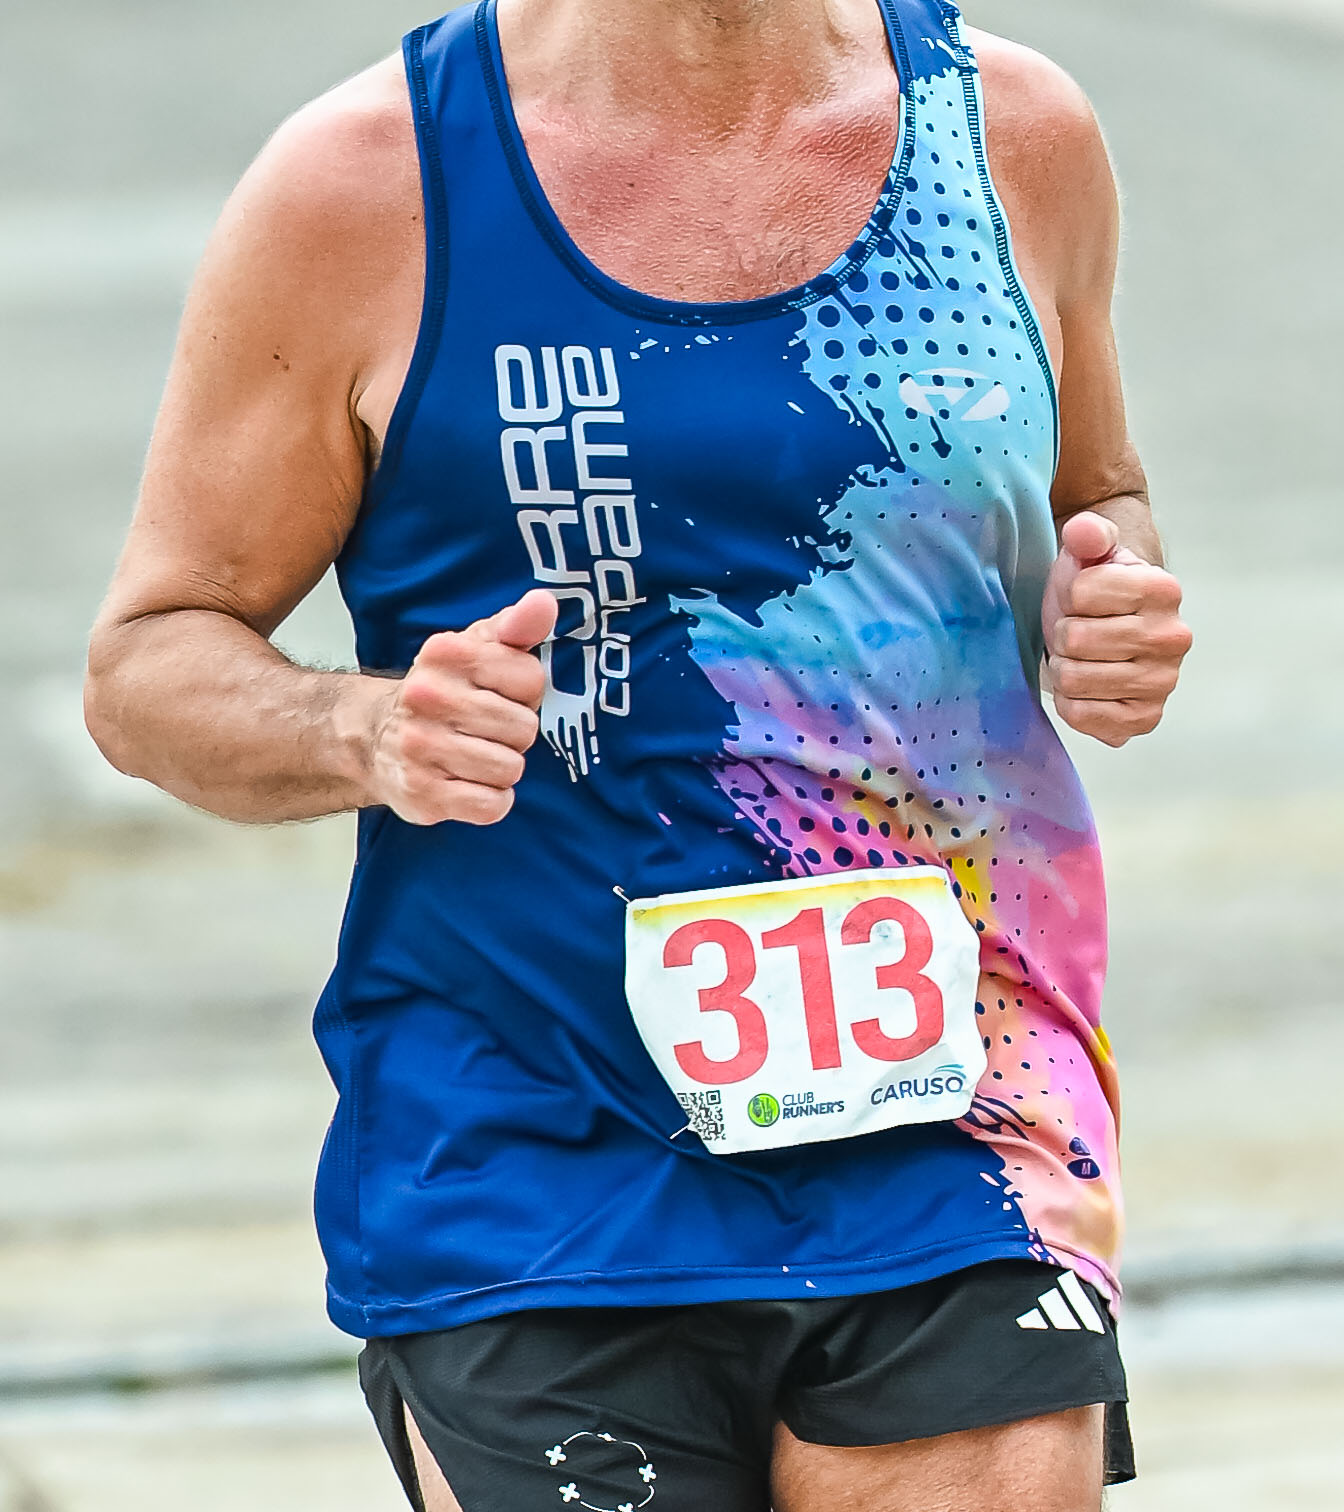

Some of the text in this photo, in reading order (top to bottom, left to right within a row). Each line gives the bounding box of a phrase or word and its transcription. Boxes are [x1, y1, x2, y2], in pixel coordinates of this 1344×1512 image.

[663, 897, 945, 1085] 313
[782, 1092, 814, 1106] CLUB
[871, 1076, 964, 1105] CARUSO
[782, 1101, 845, 1120] RUNNER'S
